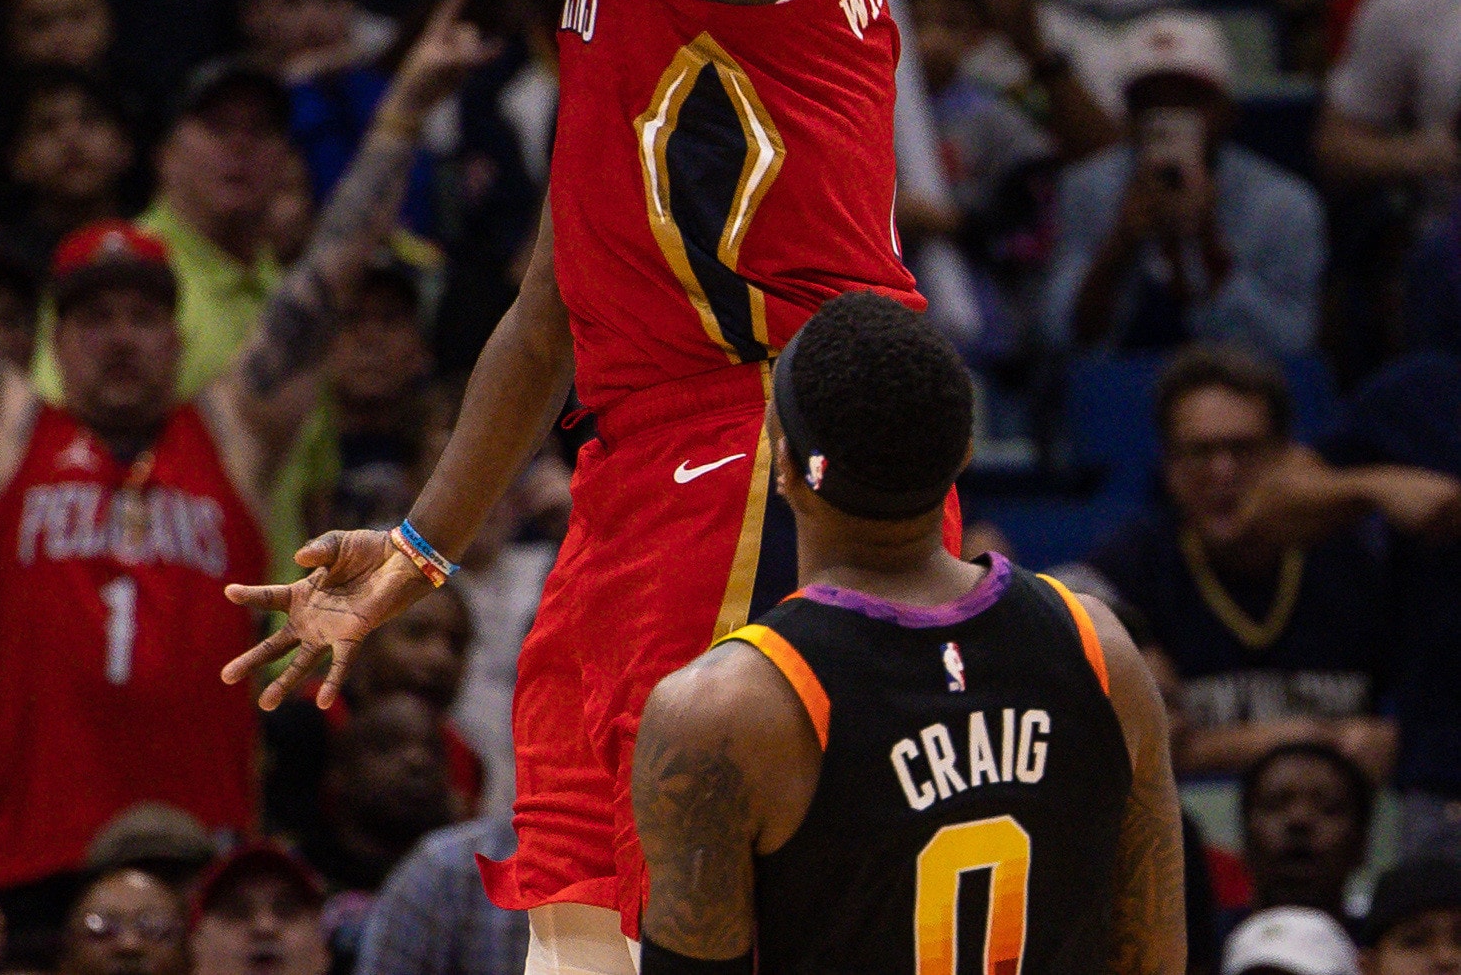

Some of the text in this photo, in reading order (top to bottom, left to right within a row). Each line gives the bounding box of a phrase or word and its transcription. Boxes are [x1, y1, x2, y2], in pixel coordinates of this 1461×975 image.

[99, 575, 137, 684] 1
[890, 708, 1051, 812] CRAIG
[914, 814, 1031, 975] 0
